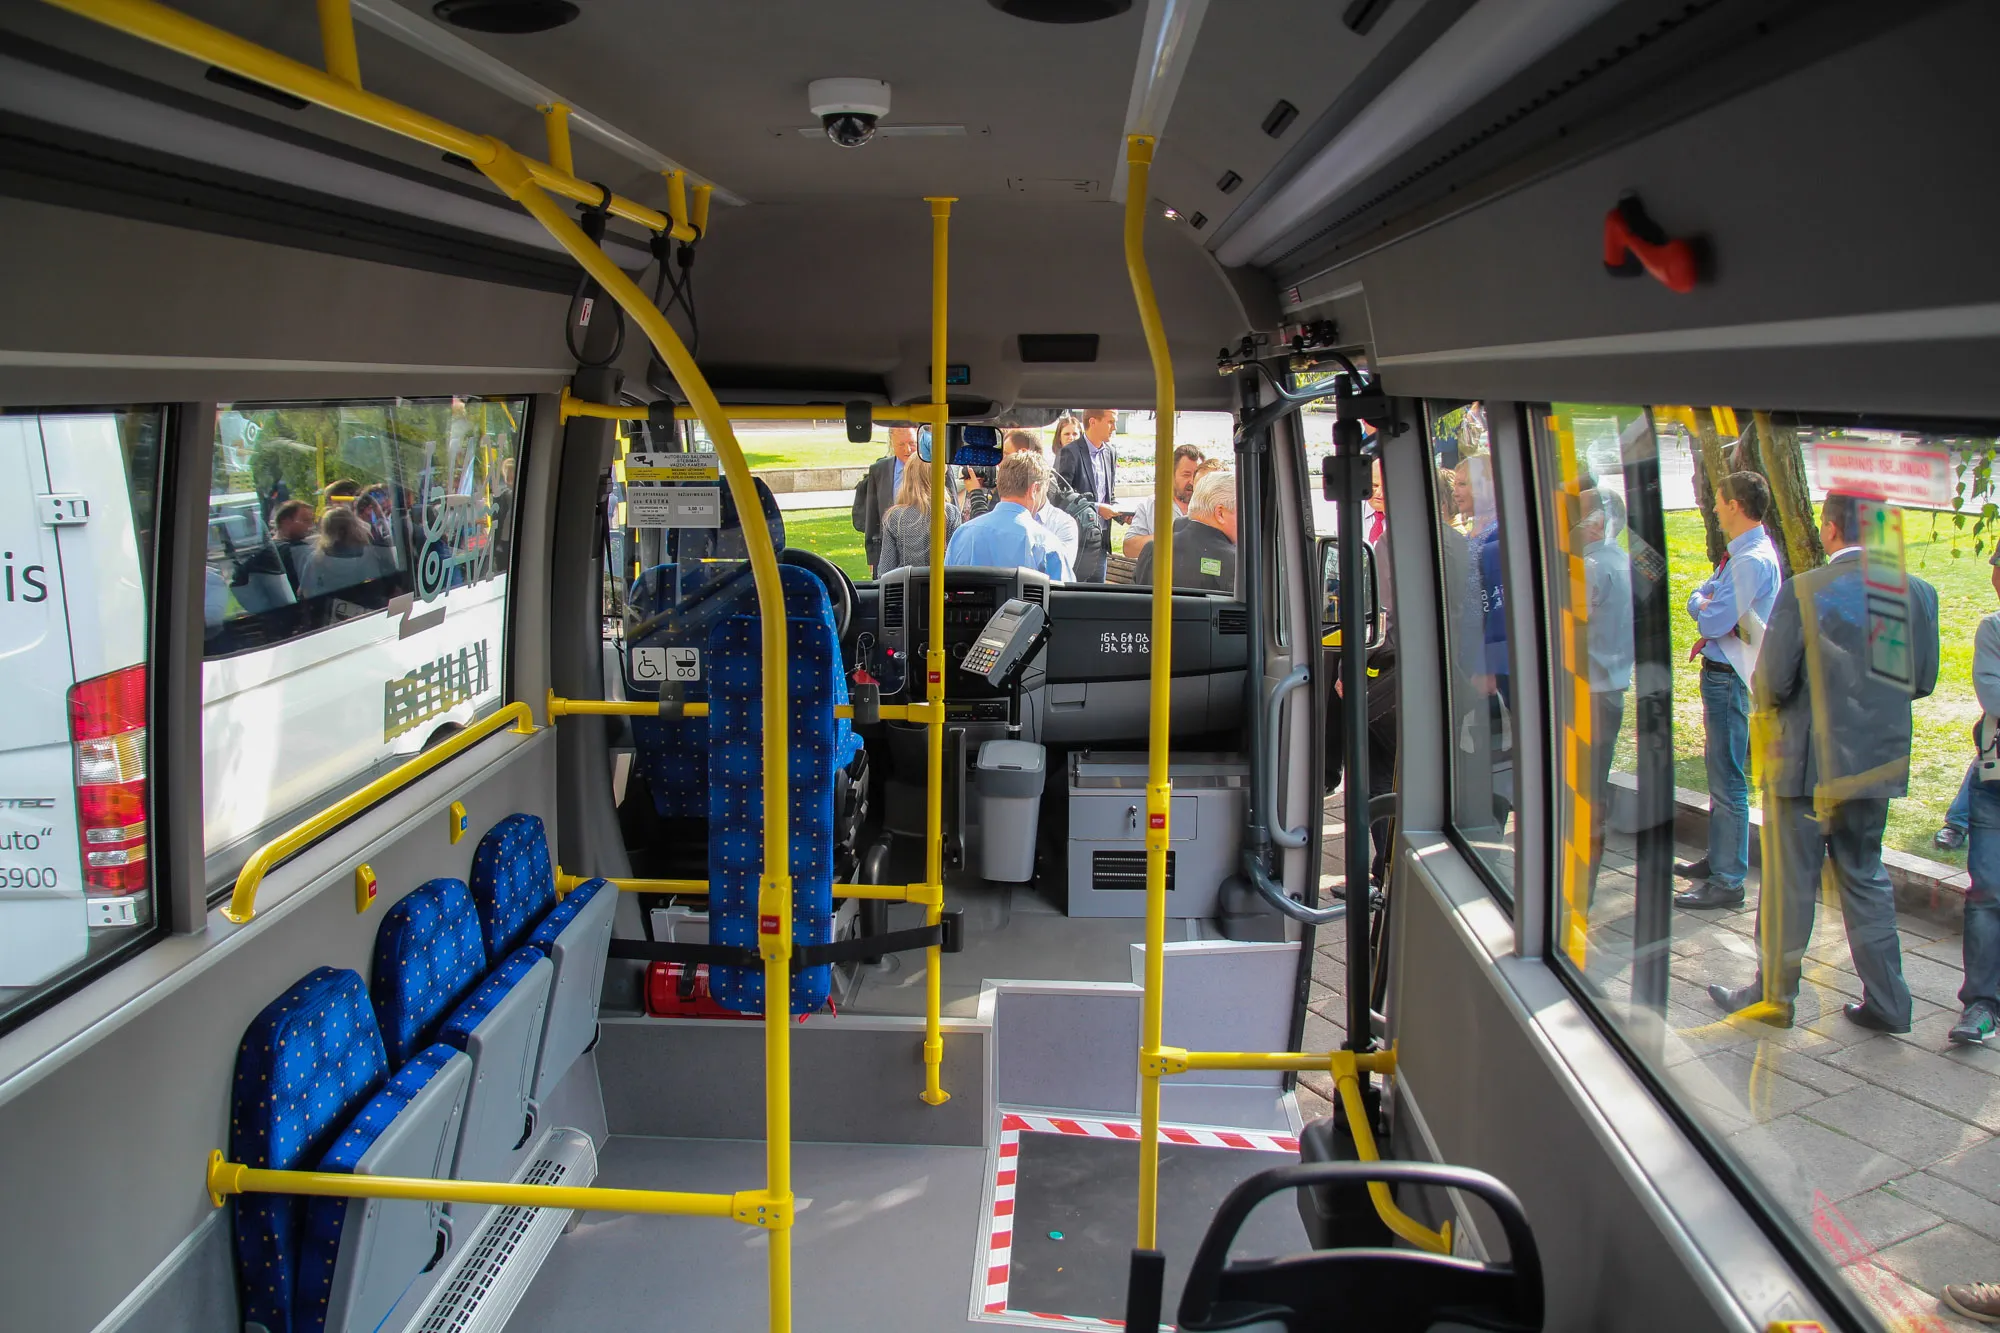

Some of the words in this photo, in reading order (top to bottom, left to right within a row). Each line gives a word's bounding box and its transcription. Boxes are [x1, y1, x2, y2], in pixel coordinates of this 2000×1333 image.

[4, 551, 48, 603] is
[1100, 632, 1110, 643] 16
[1120, 632, 1127, 643] 6
[1100, 643, 1110, 653] 13
[1120, 643, 1127, 653] 5
[762, 920, 777, 928] STOP
